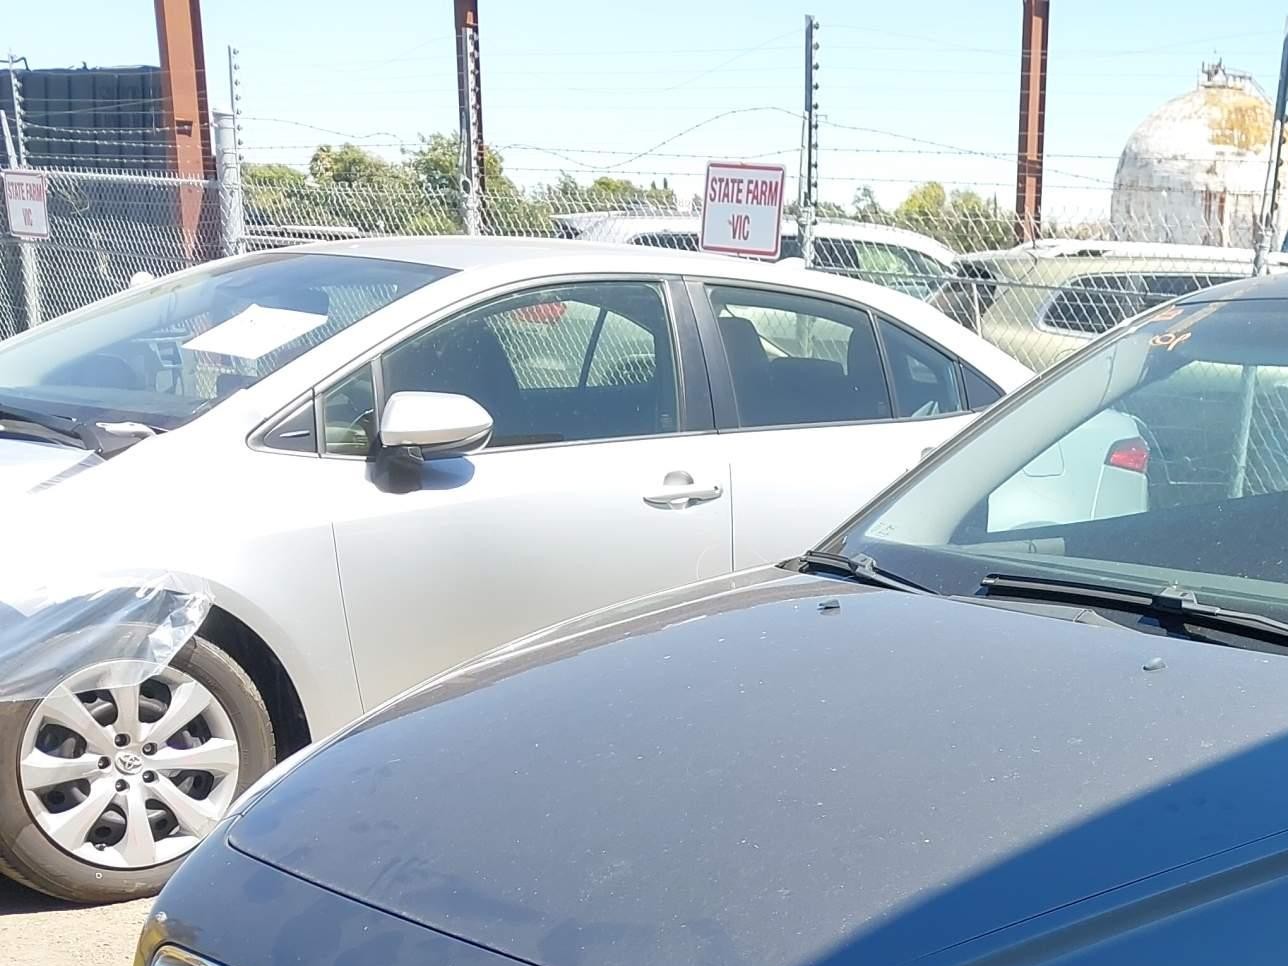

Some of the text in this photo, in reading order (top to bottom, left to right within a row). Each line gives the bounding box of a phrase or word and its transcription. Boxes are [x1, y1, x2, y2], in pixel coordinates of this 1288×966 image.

[7, 182, 24, 200] STATE
[709, 176, 779, 207] STATE FARM
[731, 214, 750, 241] VIC
